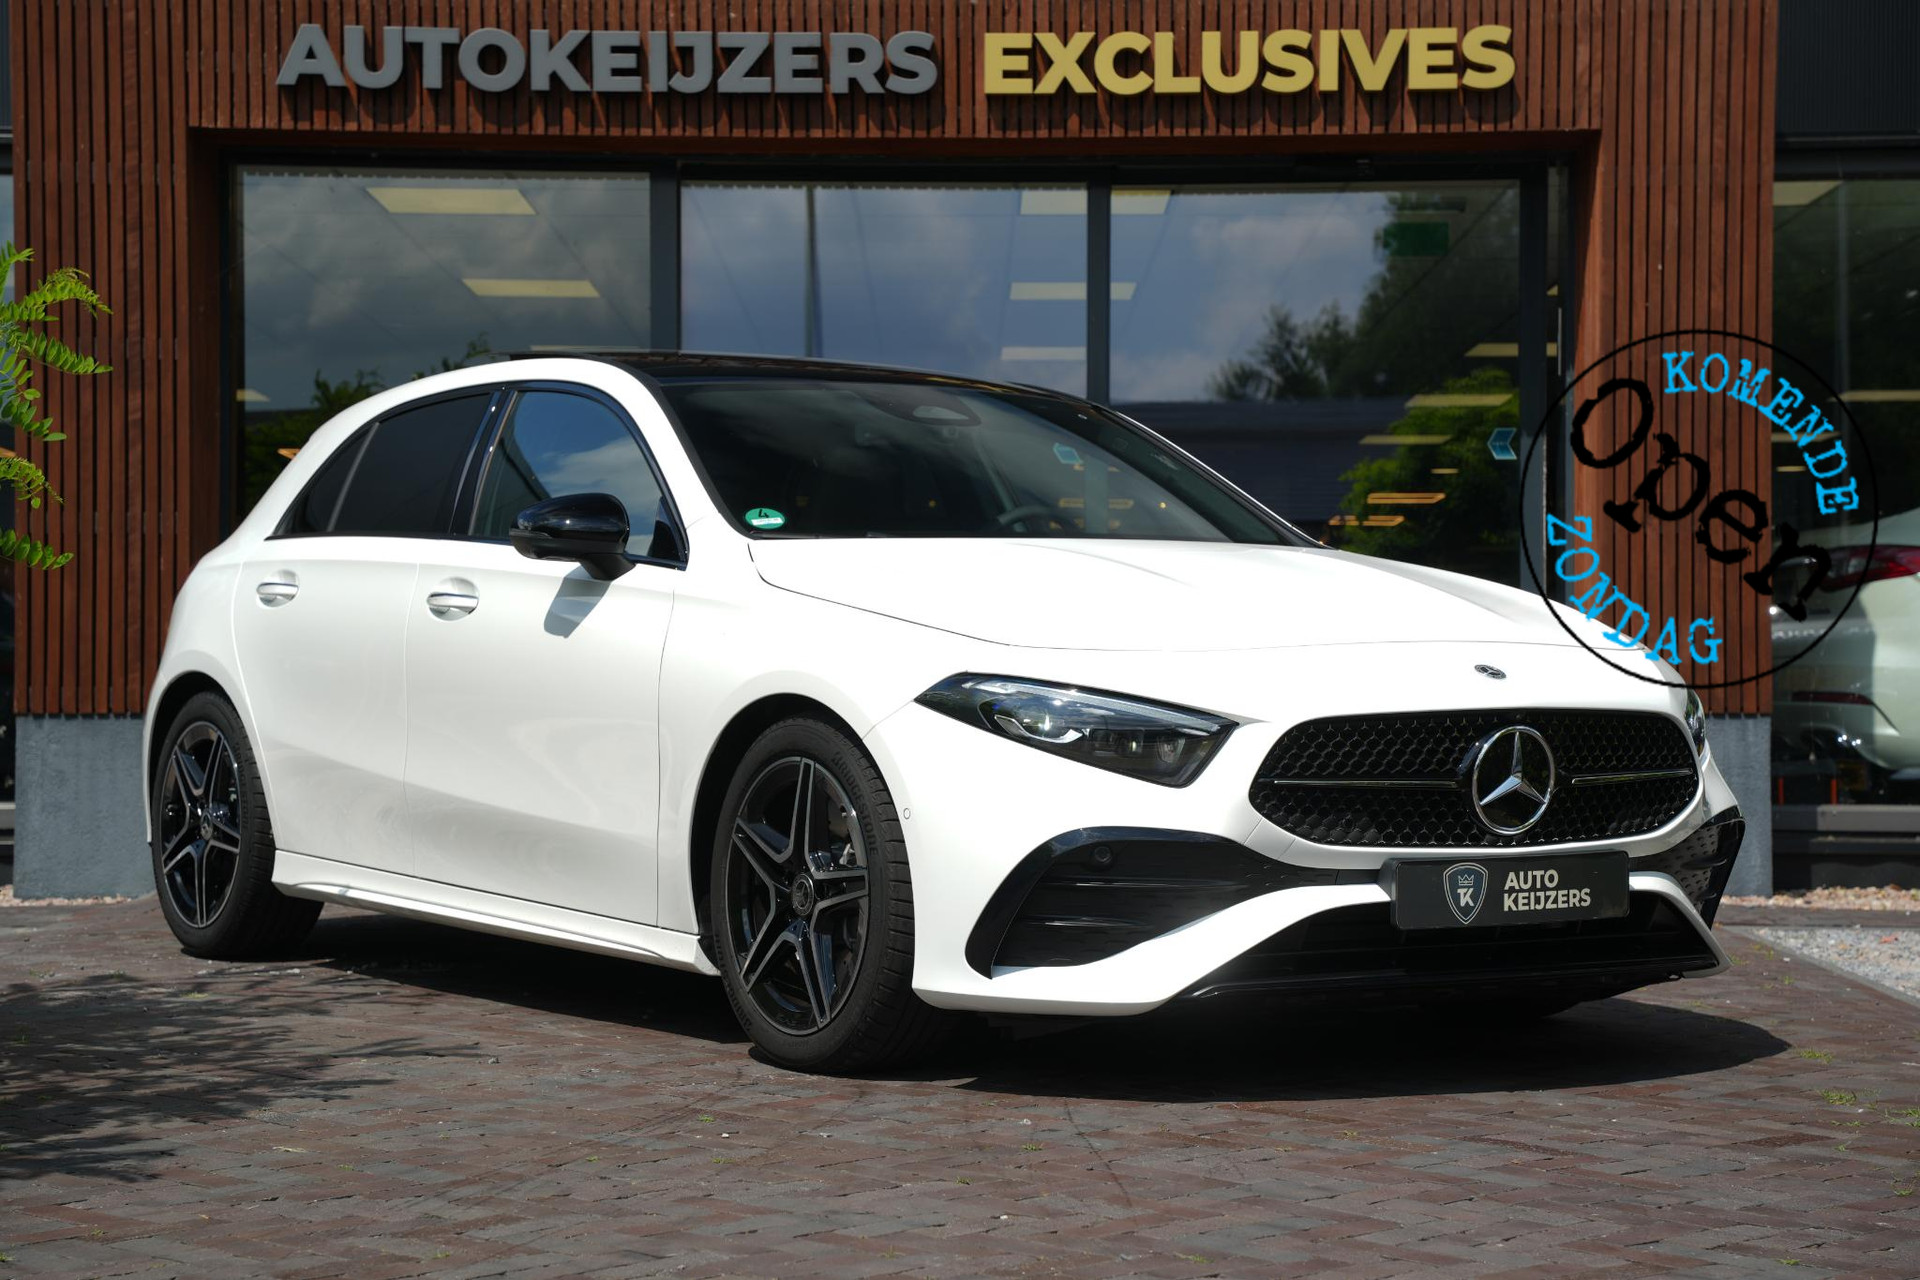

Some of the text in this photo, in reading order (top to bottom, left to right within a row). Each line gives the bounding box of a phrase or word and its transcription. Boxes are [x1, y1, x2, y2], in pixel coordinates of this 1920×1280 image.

[277, 23, 1516, 95] AUTOKEIJZERS EXCLUSIVES
[831, 751, 879, 857] BRIDGESTONE
[1503, 888, 1592, 911] KEIJZERS
[1504, 869, 1559, 890] AUTO
